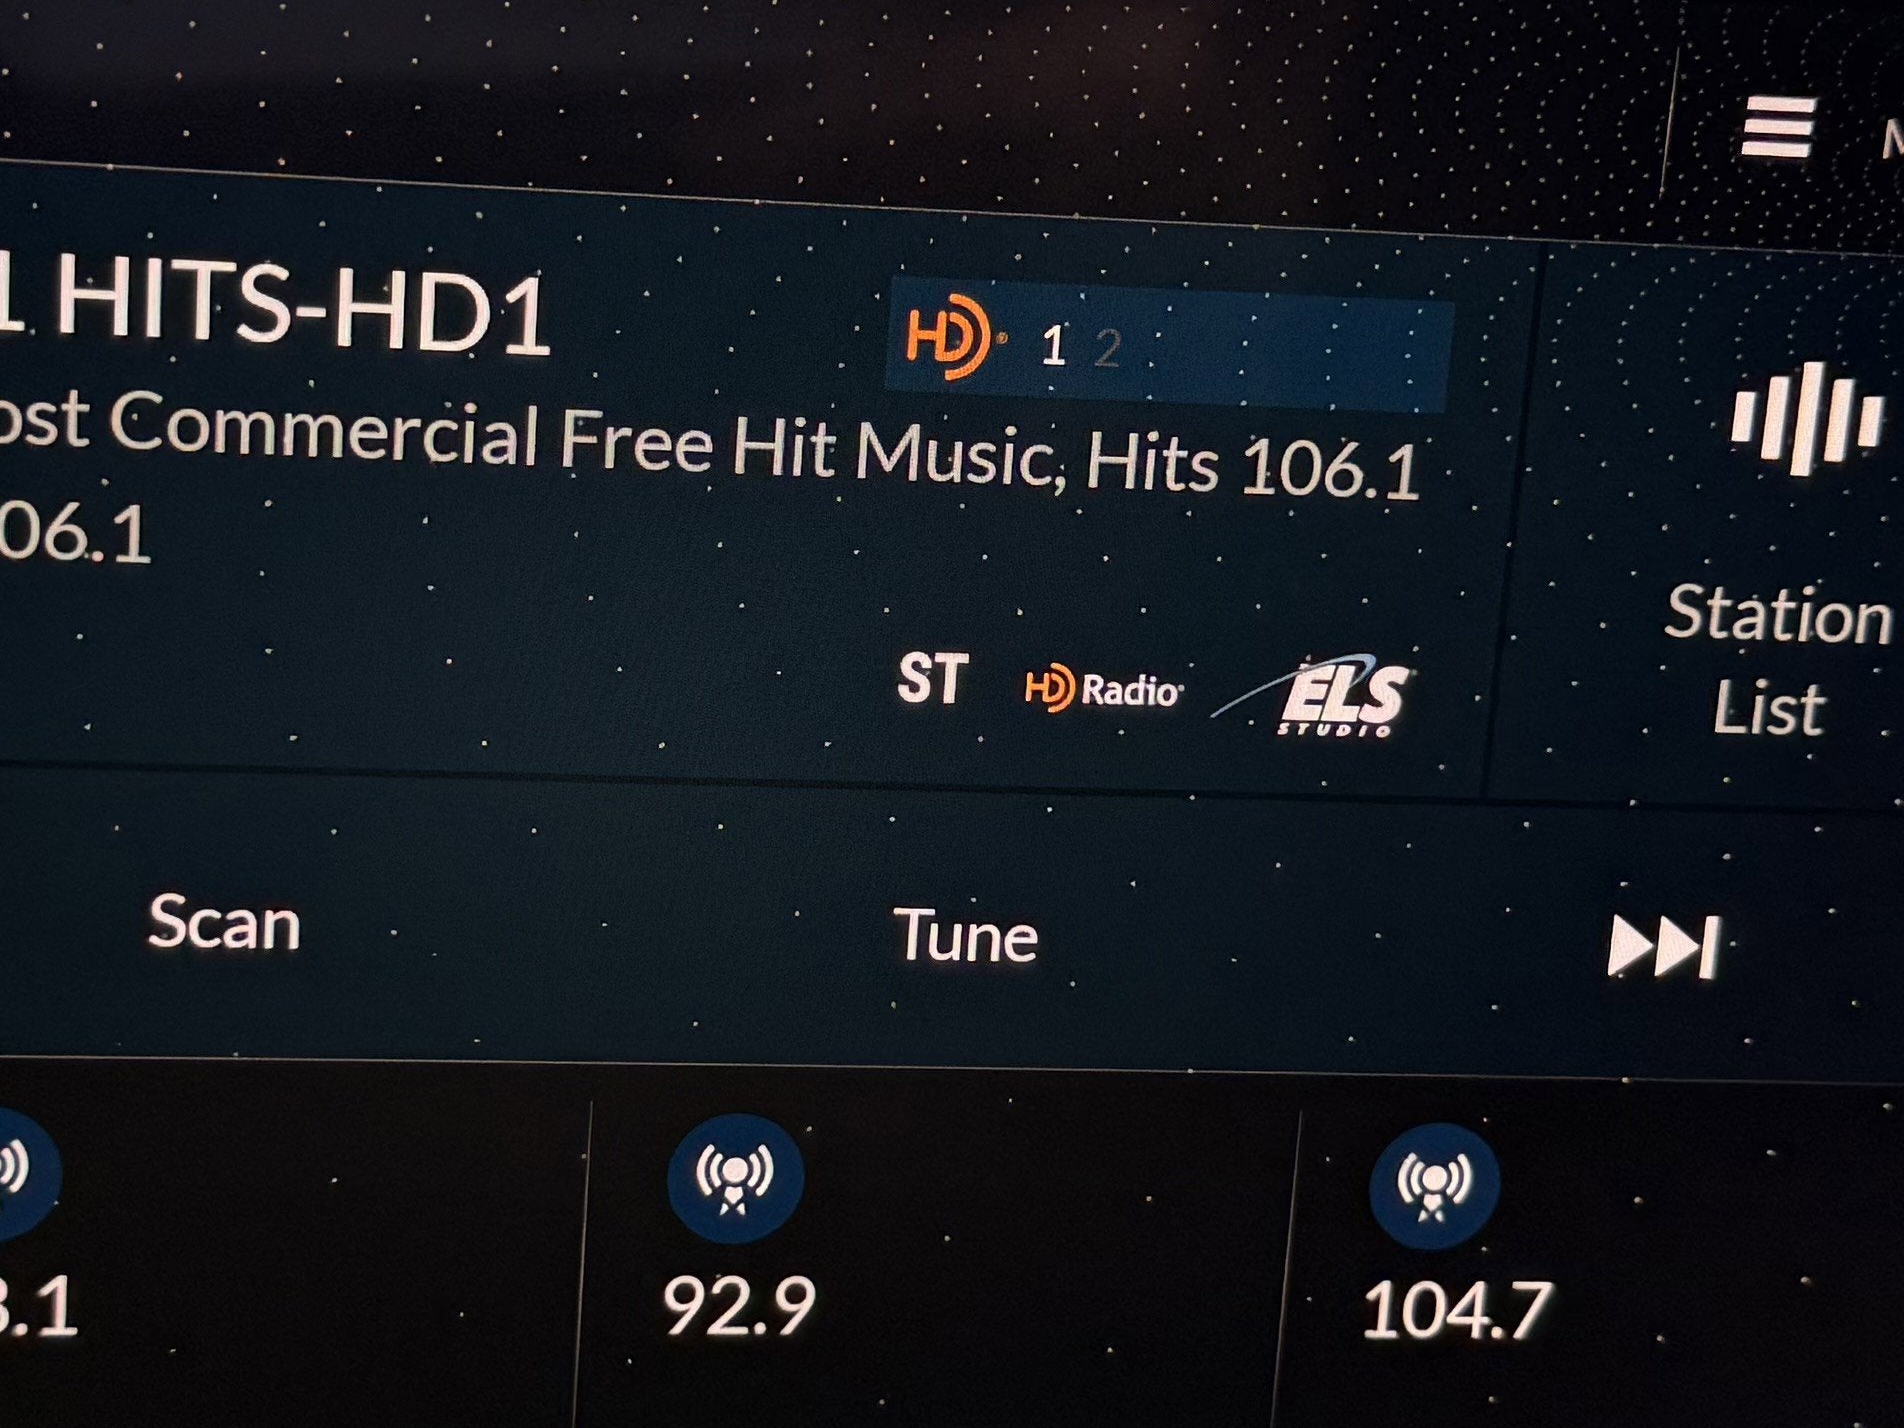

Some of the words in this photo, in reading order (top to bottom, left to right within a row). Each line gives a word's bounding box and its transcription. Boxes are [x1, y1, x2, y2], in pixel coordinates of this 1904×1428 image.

[60, 253, 550, 355] HITS-HD1
[1043, 324, 1066, 367] 1
[111, 391, 537, 465] Commercial
[563, 409, 712, 472] Free
[735, 417, 836, 477] Hit
[858, 422, 1065, 496] Music,
[1088, 431, 1218, 492] Hits
[1244, 439, 1418, 500] 106.1
[1665, 584, 1891, 644] Station
[898, 651, 969, 704] ST
[1082, 673, 1177, 707] Radio
[1282, 664, 1410, 724] ELS
[1277, 722, 1391, 738] STUDIO
[1715, 679, 1826, 735] List
[149, 893, 299, 949] Scan
[893, 908, 1038, 962] Tune
[665, 1275, 815, 1335] 92.9
[1365, 1280, 1553, 1339] 104.7
